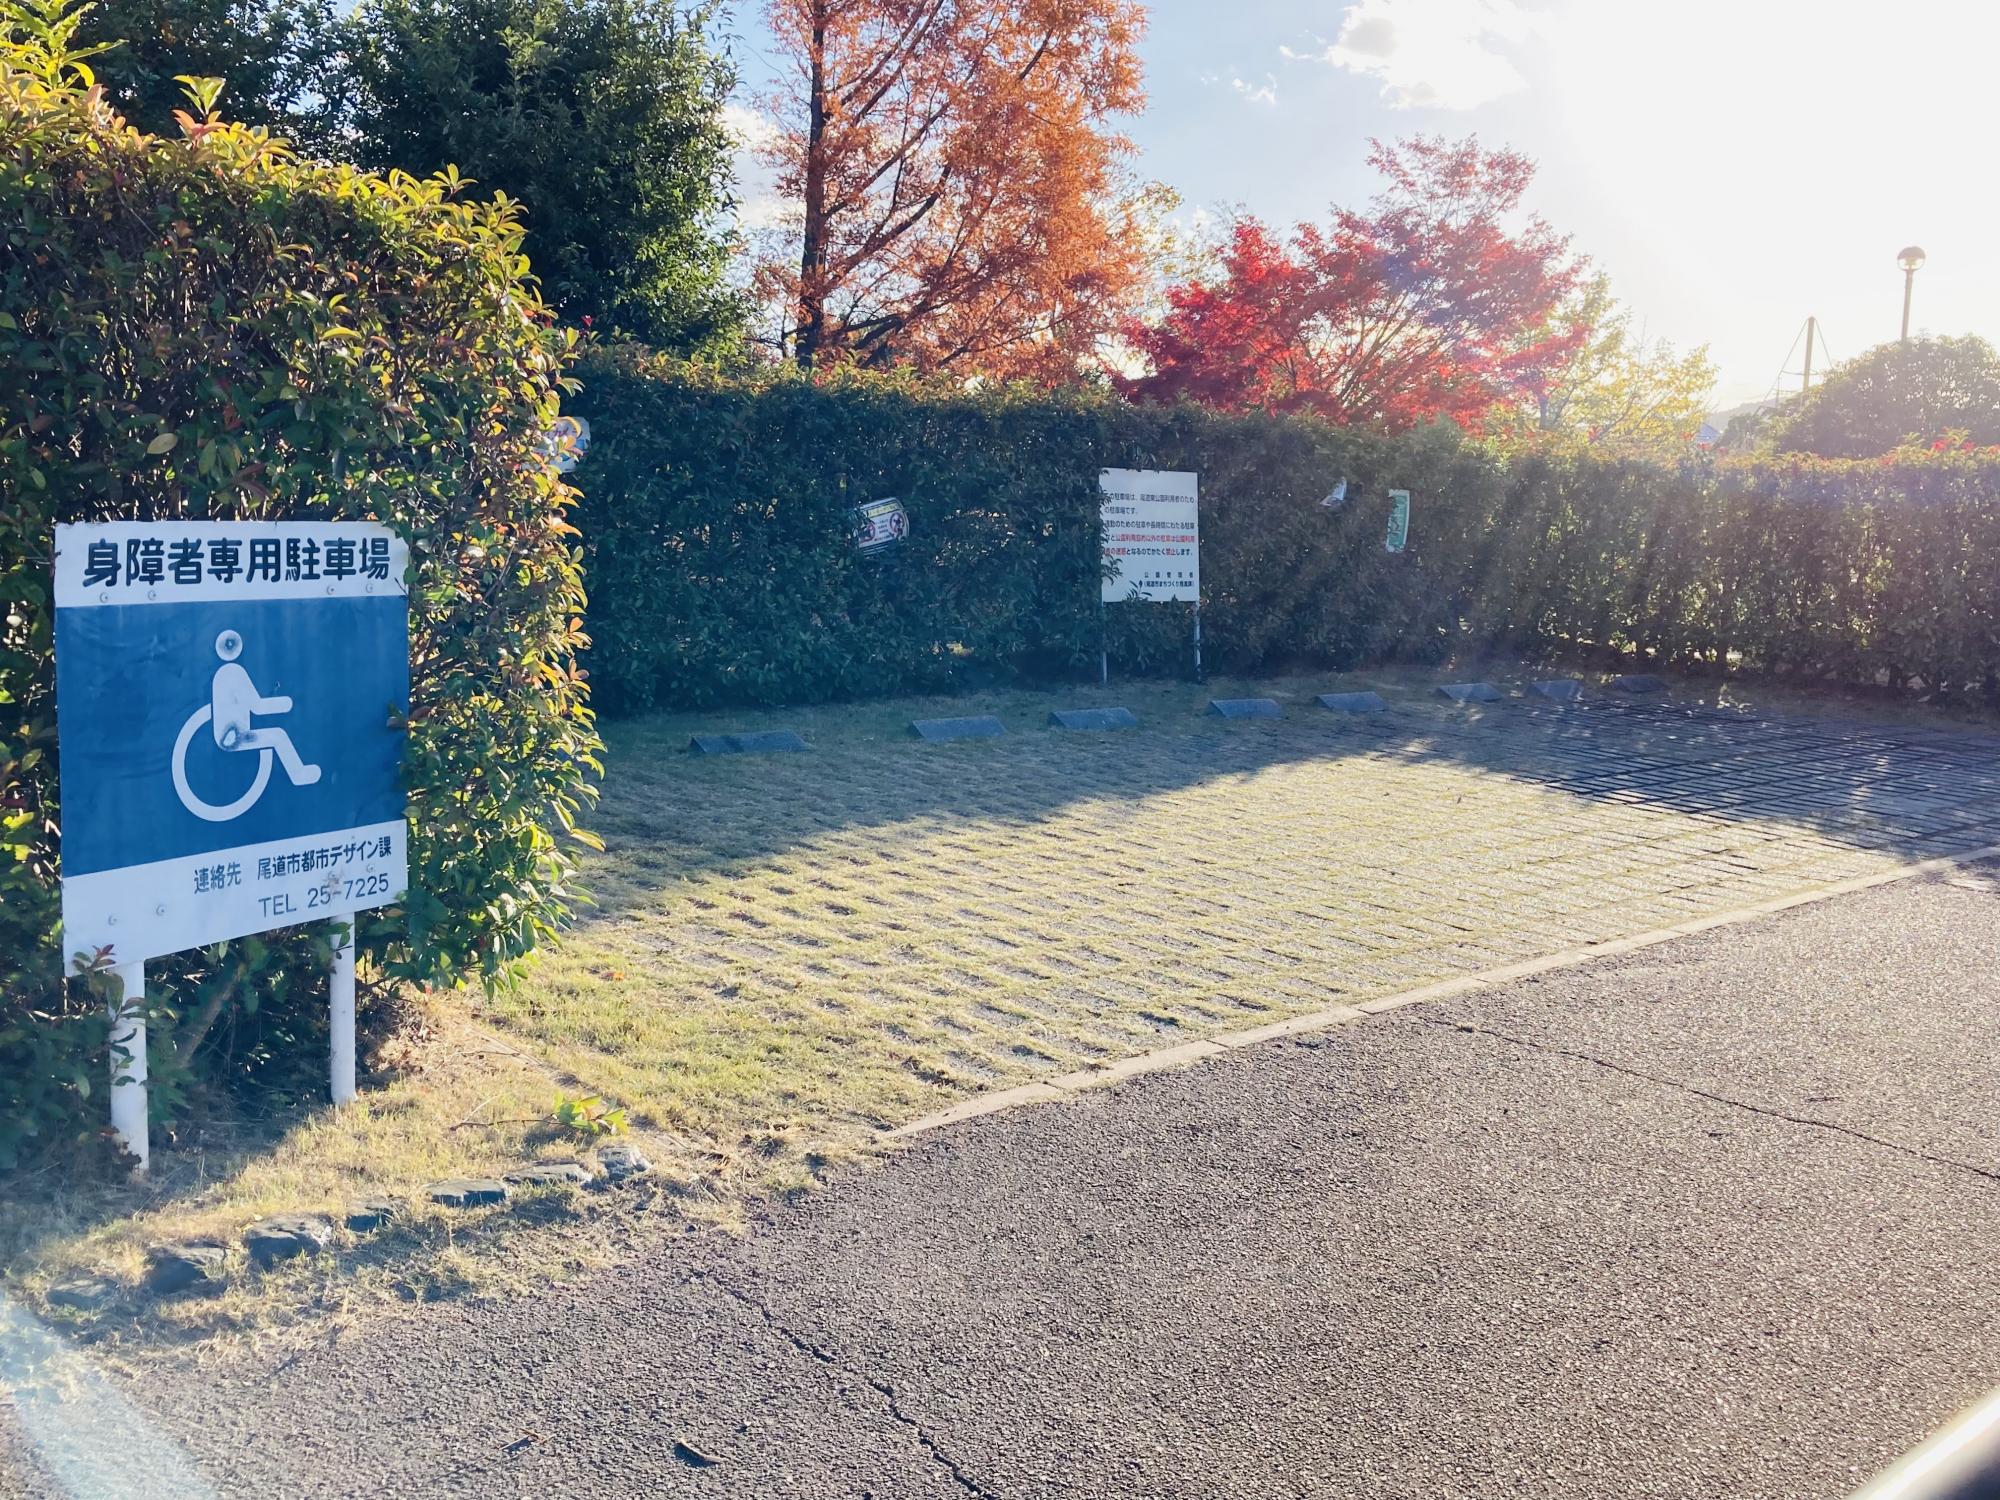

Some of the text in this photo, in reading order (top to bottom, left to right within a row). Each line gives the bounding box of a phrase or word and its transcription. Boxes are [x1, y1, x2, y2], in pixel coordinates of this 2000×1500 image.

[82, 537, 390, 587] 身障者専用駐車場
[194, 836, 391, 894] 連絡先 尾道市都市デザイン課
[258, 873, 389, 918] TEL 25-7225
